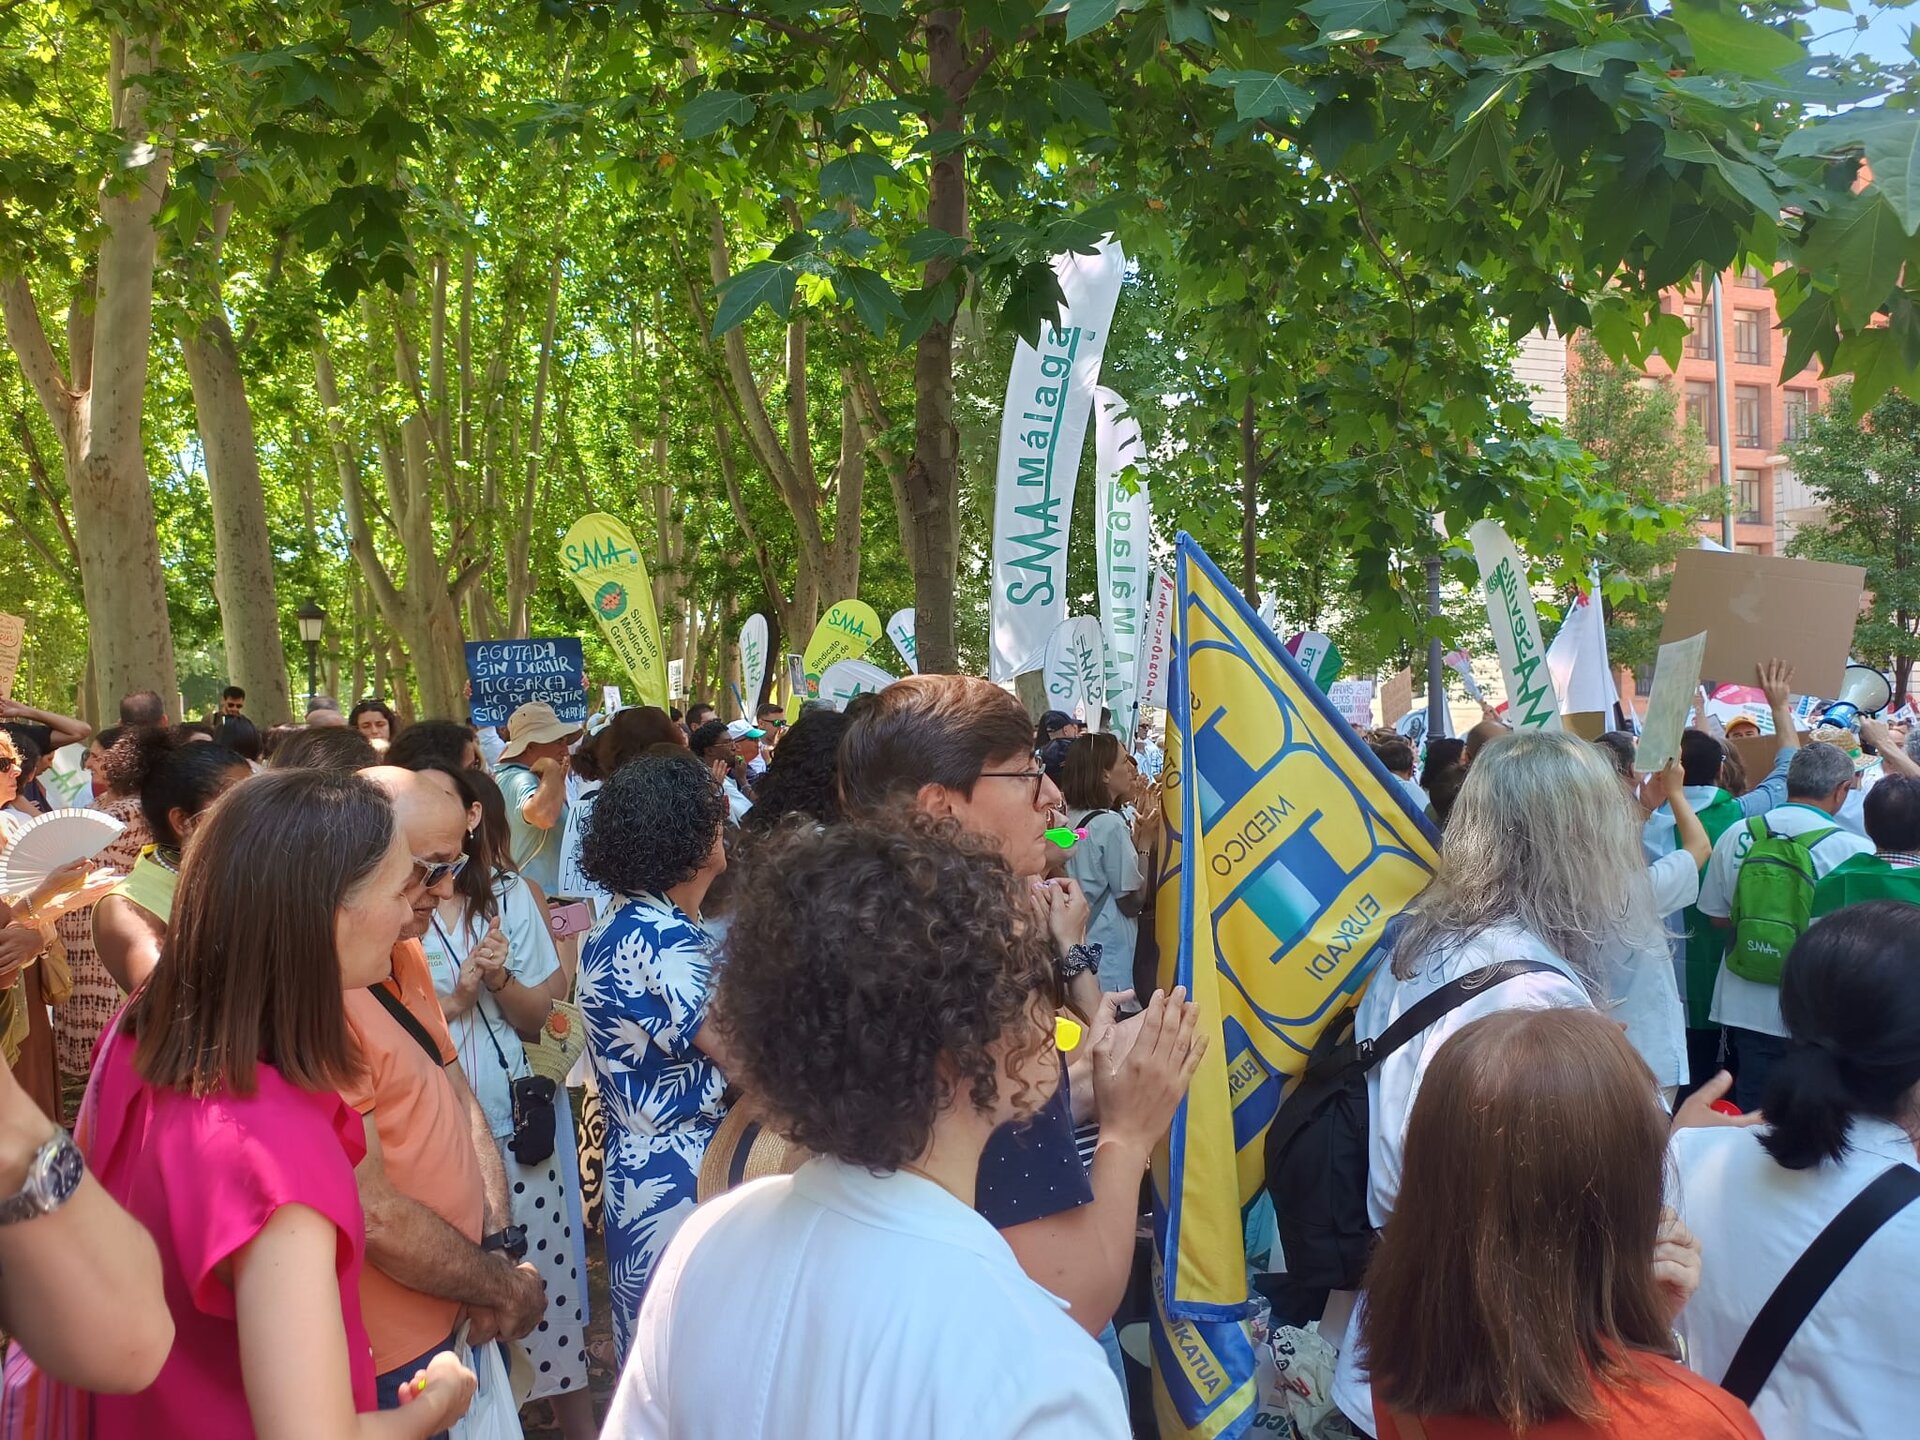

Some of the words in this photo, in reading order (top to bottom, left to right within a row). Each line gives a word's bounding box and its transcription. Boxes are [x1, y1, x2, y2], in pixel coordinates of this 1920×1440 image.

[1017, 327, 1072, 486] Málaga
[565, 536, 632, 573] SMA
[1006, 497, 1062, 606] SMA
[630, 608, 658, 658] Sindicato
[828, 608, 872, 637] SMA
[476, 641, 556, 662] AGOTADA
[611, 625, 637, 670] Granada
[620, 617, 642, 655] Médico
[640, 656, 651, 670] de
[811, 640, 840, 669] Sindicato
[840, 644, 850, 655] de
[476, 661, 509, 676] SIN
[516, 656, 575, 675] DORMIR
[510, 694, 526, 704] DE
[531, 686, 583, 704] ASISTIR
[473, 704, 508, 721] STOP
[1747, 940, 1779, 956] SMA
